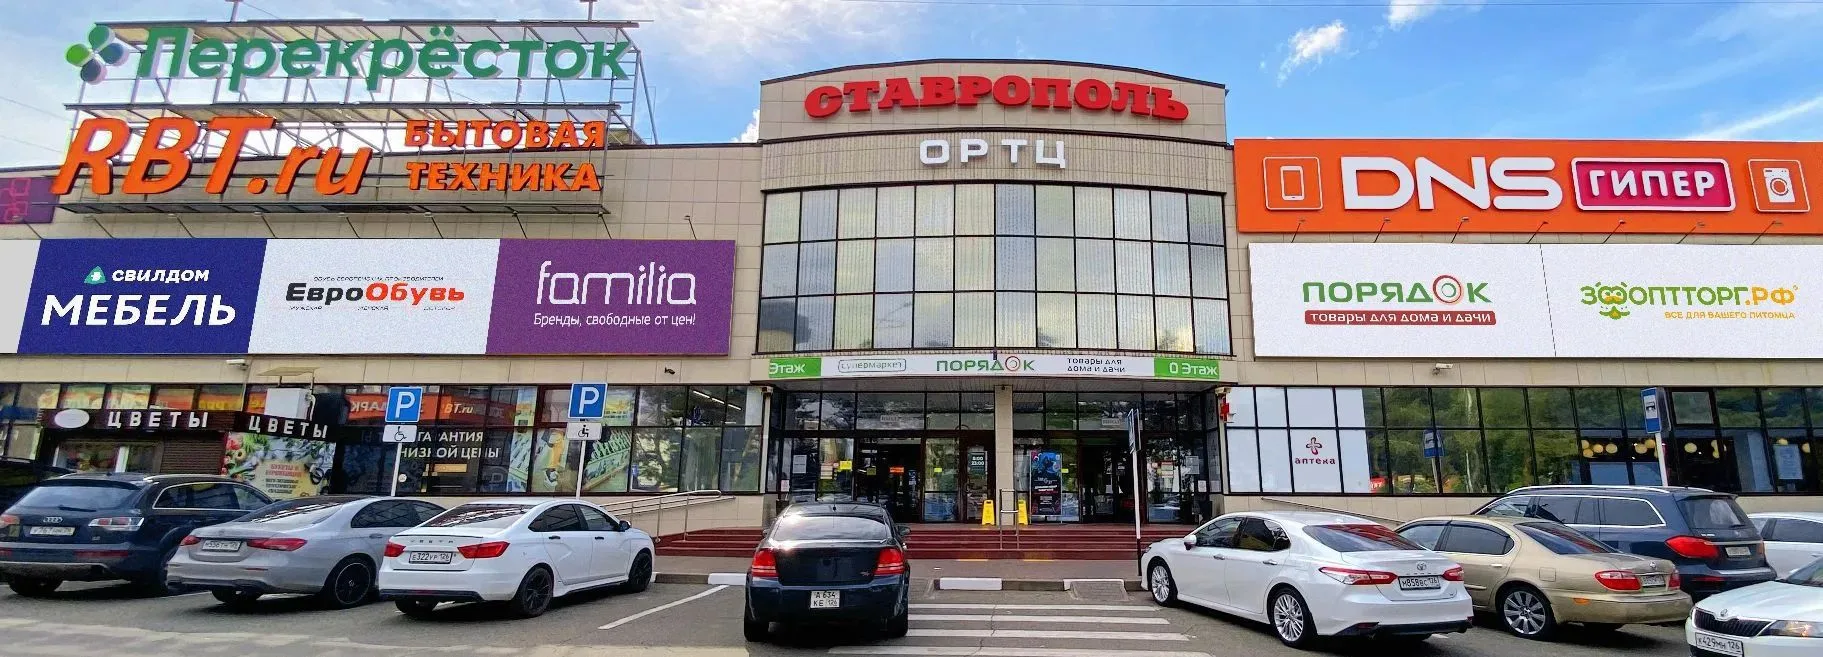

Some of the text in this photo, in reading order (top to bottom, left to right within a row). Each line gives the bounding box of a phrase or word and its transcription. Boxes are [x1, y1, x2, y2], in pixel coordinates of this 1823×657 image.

[133, 26, 629, 93] Перекрёсток
[804, 75, 1190, 121] СТАВРОПОЛЬ
[404, 120, 606, 150] БЫТОВАЯ
[52, 117, 373, 195] RBT.ru
[405, 161, 603, 191] ТЕХНИКА
[1340, 156, 1563, 210] DNS
[1589, 169, 1716, 197] ГИПЕР
[112, 269, 210, 283] СВИЛДОМ
[536, 260, 697, 305] familia
[286, 282, 465, 306] ЕвроОбувь
[1302, 274, 1493, 305] ПОРЯДОК
[41, 294, 236, 326] МЕБЕЛЬ
[533, 312, 696, 327] Бренды, свободные от цен!
[1310, 313, 1491, 325] товары для дома и дачи
[1664, 311, 1795, 321] ВСЕ ДЛЯ ВАШЕГО ПИТОМЦА
[936, 356, 1035, 372] ПОРЯДОК
[1067, 357, 1103, 366] товары
[1067, 365, 1092, 373] дома
[1182, 362, 1219, 376] Этаж
[107, 411, 210, 429] ЦВЕТЫ
[248, 415, 329, 439] ЦВЕТЫ
[418, 431, 484, 442] ГААНТИЯ
[1295, 457, 1336, 465] аптека
